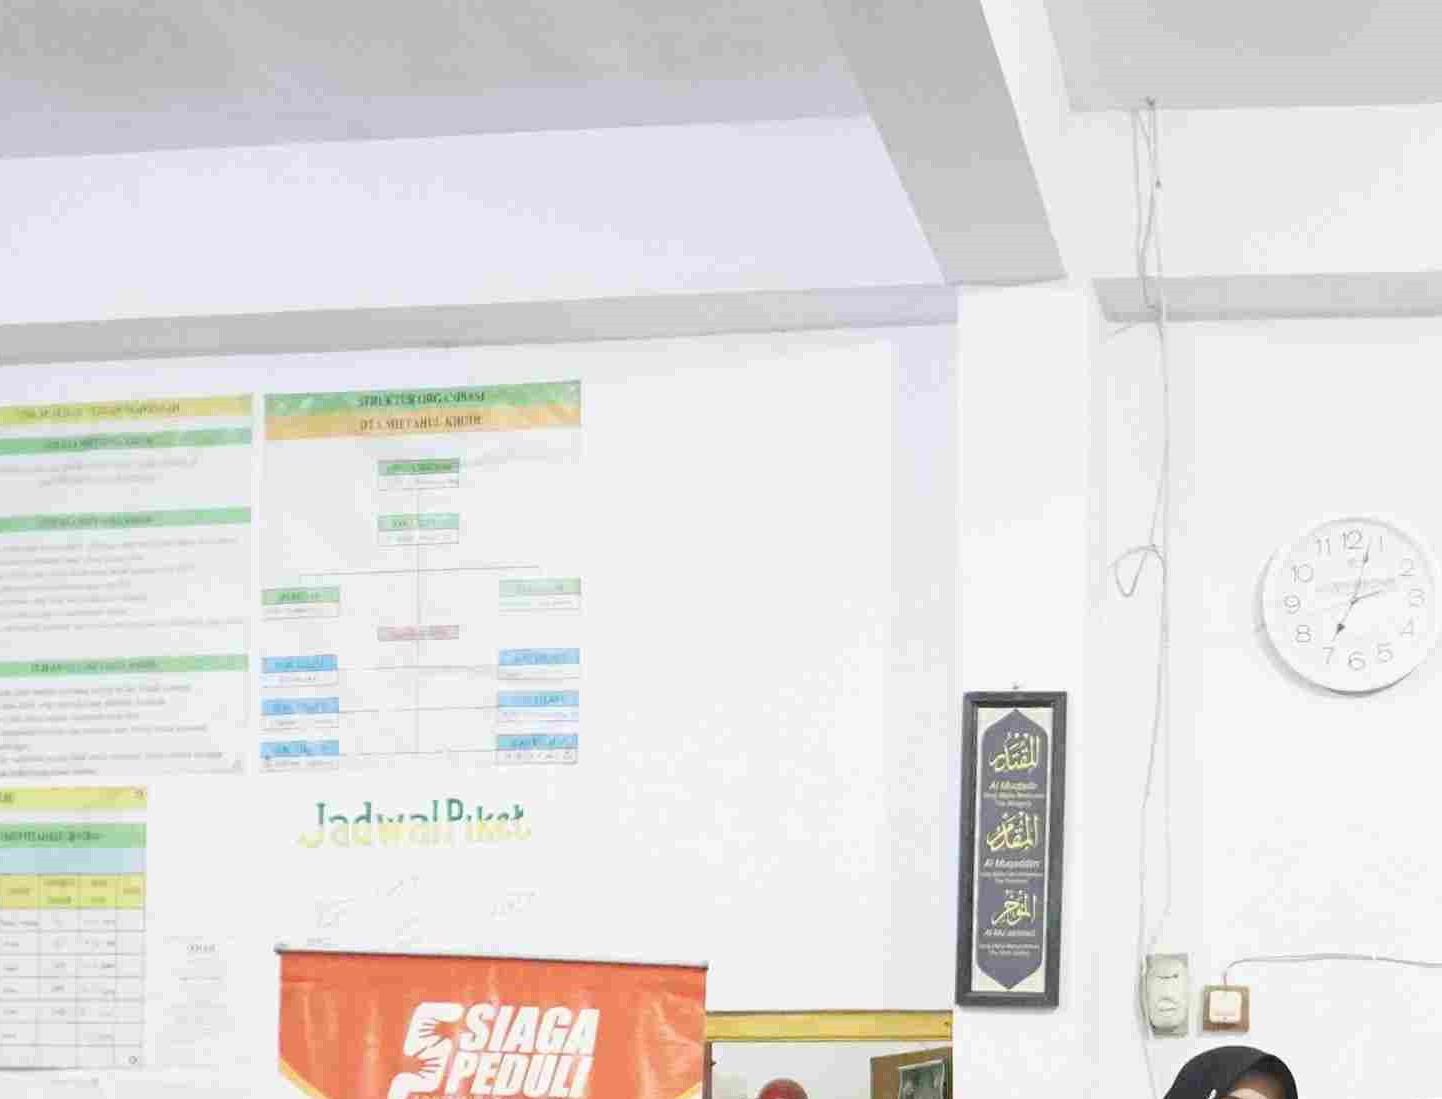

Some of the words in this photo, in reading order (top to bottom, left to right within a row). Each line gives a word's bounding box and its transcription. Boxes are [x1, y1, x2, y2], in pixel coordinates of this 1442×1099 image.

[1315, 537, 1331, 556] 11
[1341, 529, 1364, 549] 12
[1291, 563, 1314, 583] 10
[1284, 594, 1300, 614] 9
[1409, 587, 1426, 608] 3
[1295, 624, 1312, 643] 8
[1323, 646, 1334, 664] 7
[1347, 650, 1366, 671] 6
[1377, 641, 1394, 663] 5
[459, 1004, 600, 1055] SIAGA
[446, 1052, 595, 1099] PEDULI
